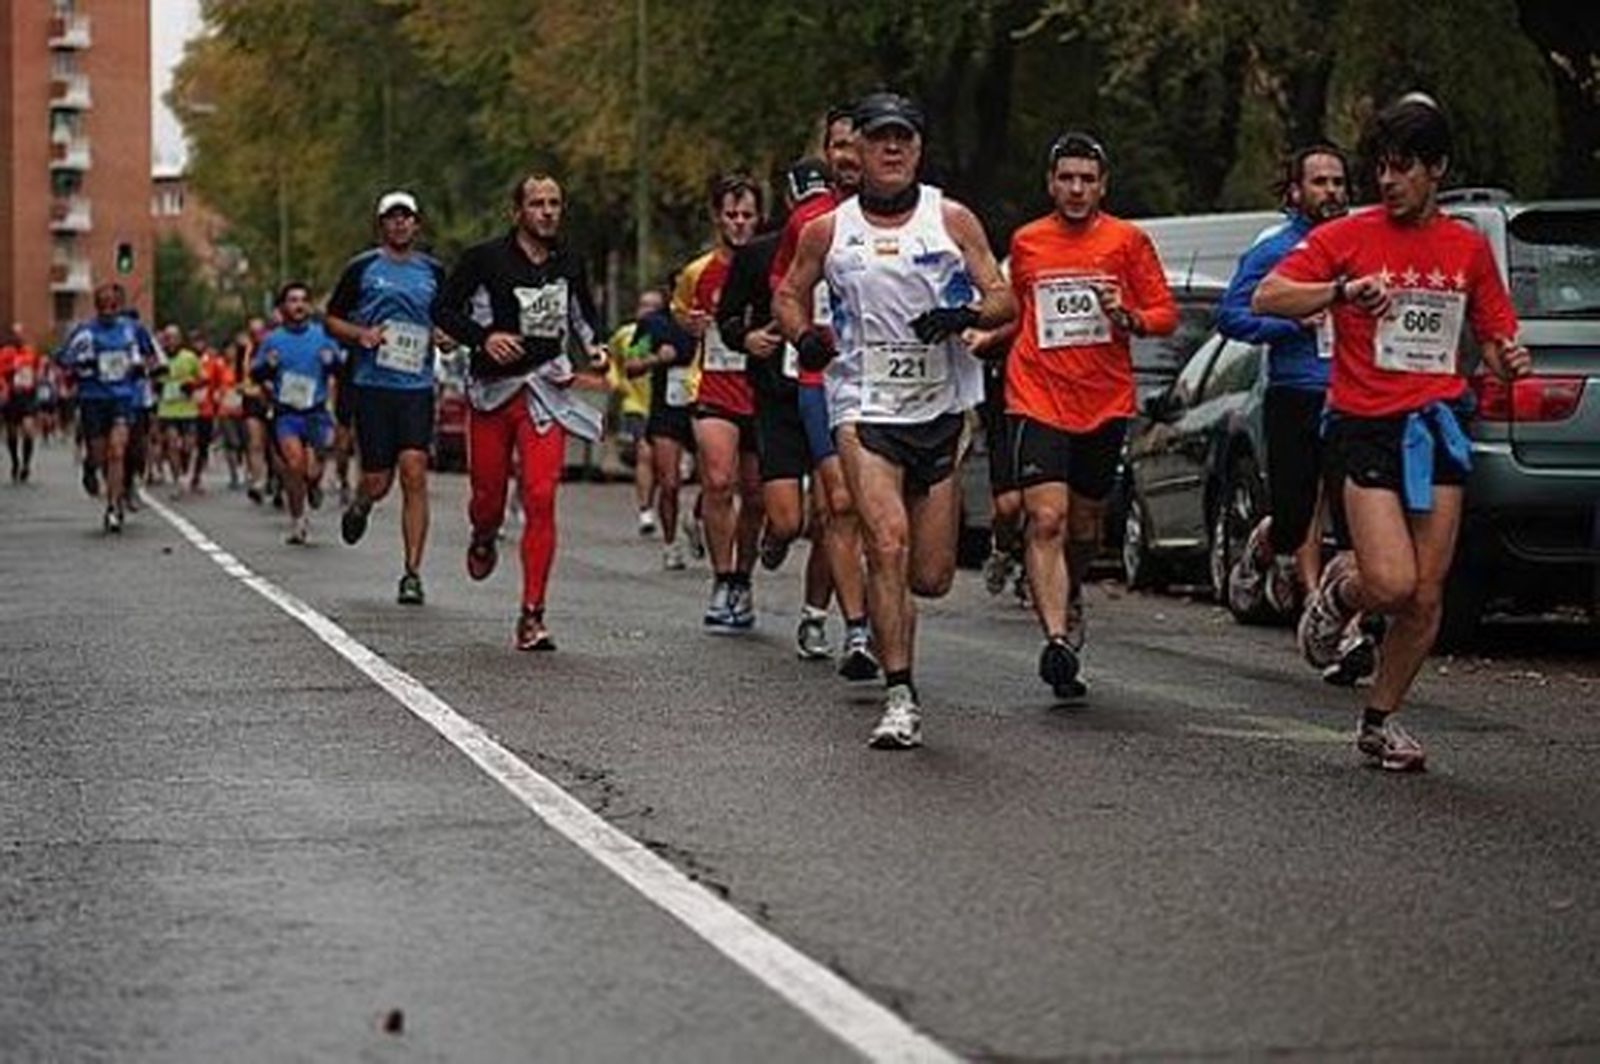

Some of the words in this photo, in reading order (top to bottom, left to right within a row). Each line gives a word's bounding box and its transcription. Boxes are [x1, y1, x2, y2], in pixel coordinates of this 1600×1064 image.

[1055, 294, 1093, 315] 650
[1402, 310, 1442, 332] 606
[889, 356, 926, 379] 221
